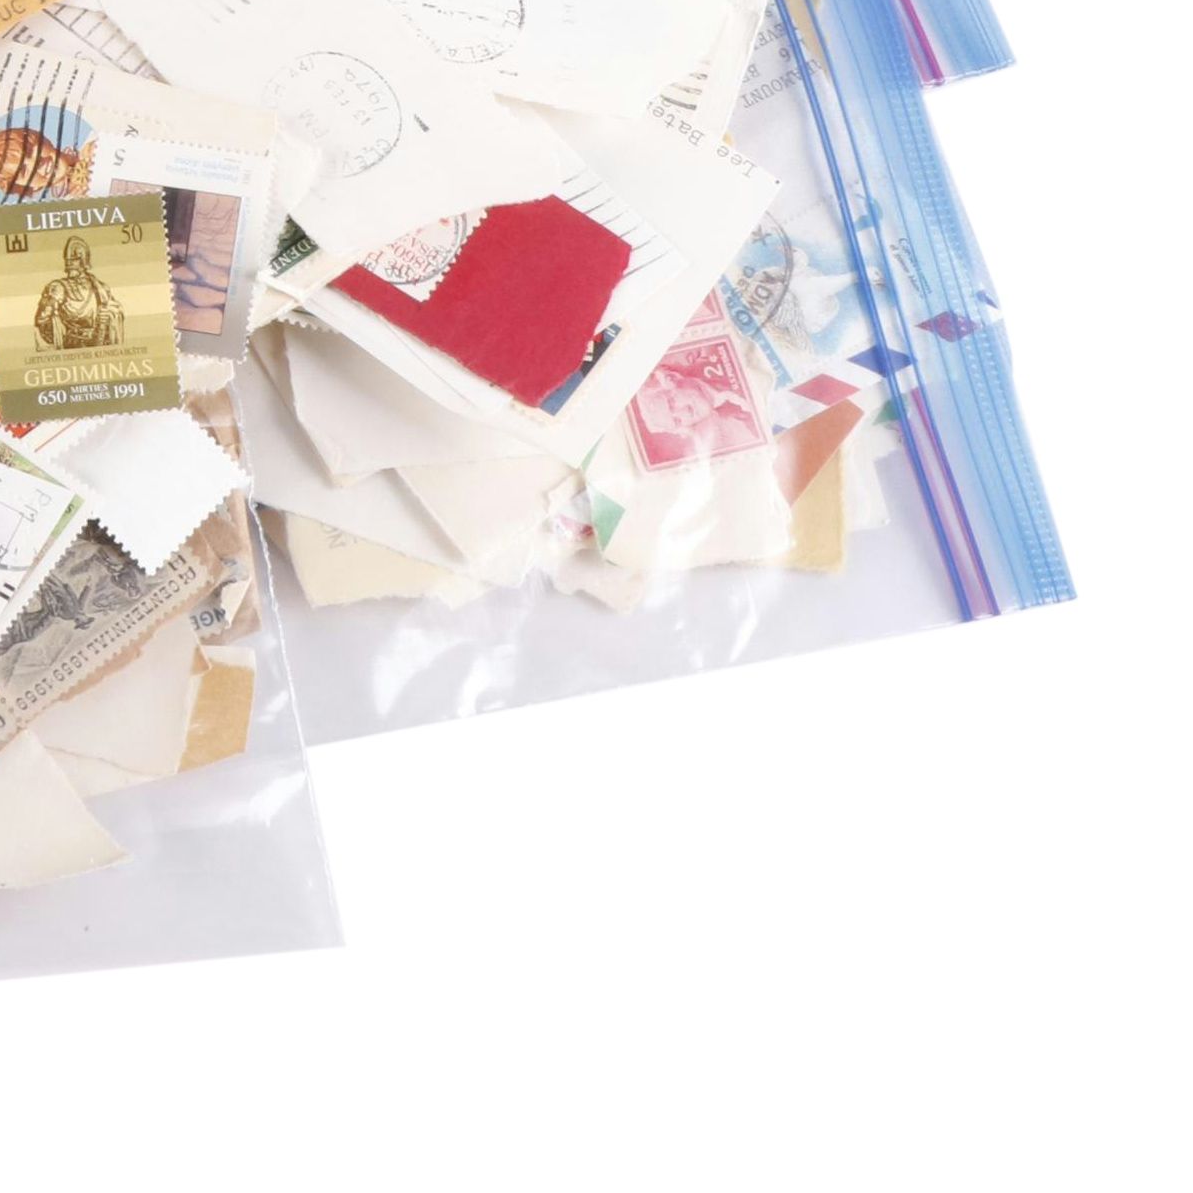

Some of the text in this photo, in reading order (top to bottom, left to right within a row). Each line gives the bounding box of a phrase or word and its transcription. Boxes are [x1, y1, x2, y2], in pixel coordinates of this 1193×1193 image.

[715, 144, 758, 180] Lee
[25, 206, 127, 232] LIETUVA
[120, 222, 144, 244] 50
[24, 358, 155, 387] GEDIMINAS
[37, 390, 68, 406] 650
[69, 383, 109, 395] MIRTIES
[113, 382, 145, 399] 1991
[93, 579, 182, 658] CENTENNIAL
